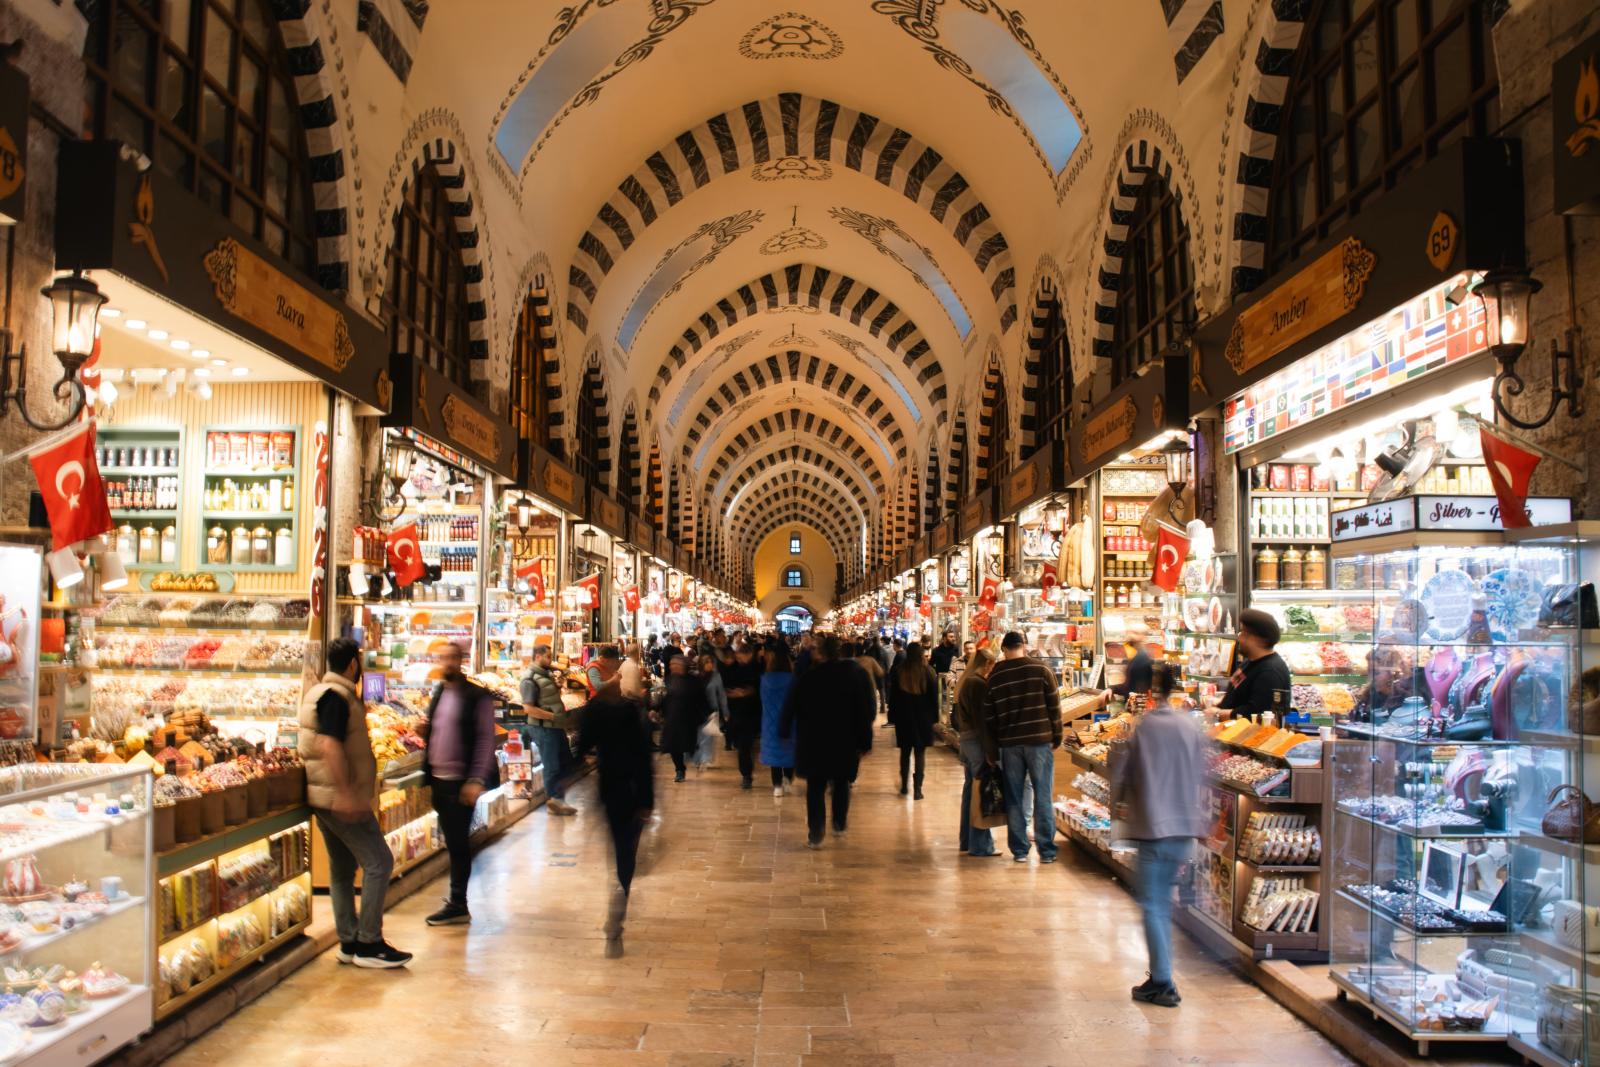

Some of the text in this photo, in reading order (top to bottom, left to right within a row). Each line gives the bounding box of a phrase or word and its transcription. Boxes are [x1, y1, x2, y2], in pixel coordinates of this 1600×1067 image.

[1432, 224, 1450, 257] 69
[276, 294, 305, 329] Rara
[1270, 296, 1309, 336] Amber
[1430, 502, 1472, 522] Silver
